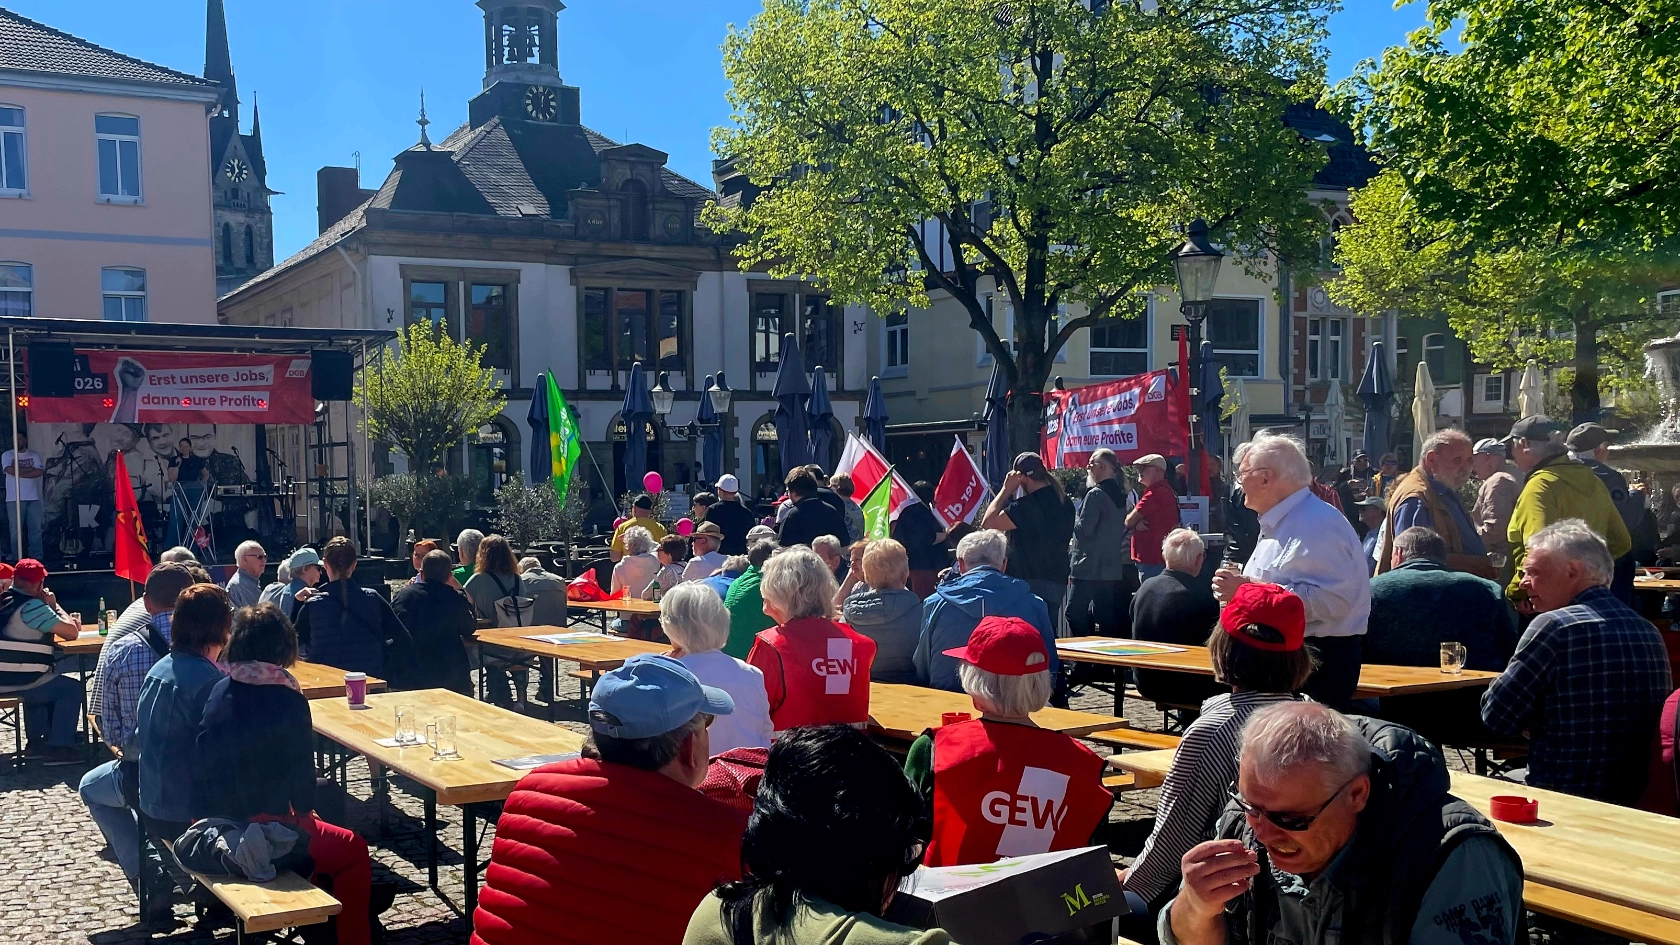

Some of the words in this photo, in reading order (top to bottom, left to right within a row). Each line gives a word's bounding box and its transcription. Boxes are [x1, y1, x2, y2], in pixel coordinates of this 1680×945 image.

[149, 374, 176, 386] Erst
[179, 372, 230, 384] unsere
[232, 370, 269, 383] Jobs,
[288, 369, 305, 377] DGB
[74, 377, 103, 390] 026
[141, 393, 180, 406] dann
[1083, 435, 1100, 446] eure
[1100, 429, 1134, 445] Profite
[811, 657, 858, 677] GEW
[980, 790, 1069, 831] GEW
[1060, 883, 1092, 916] M
